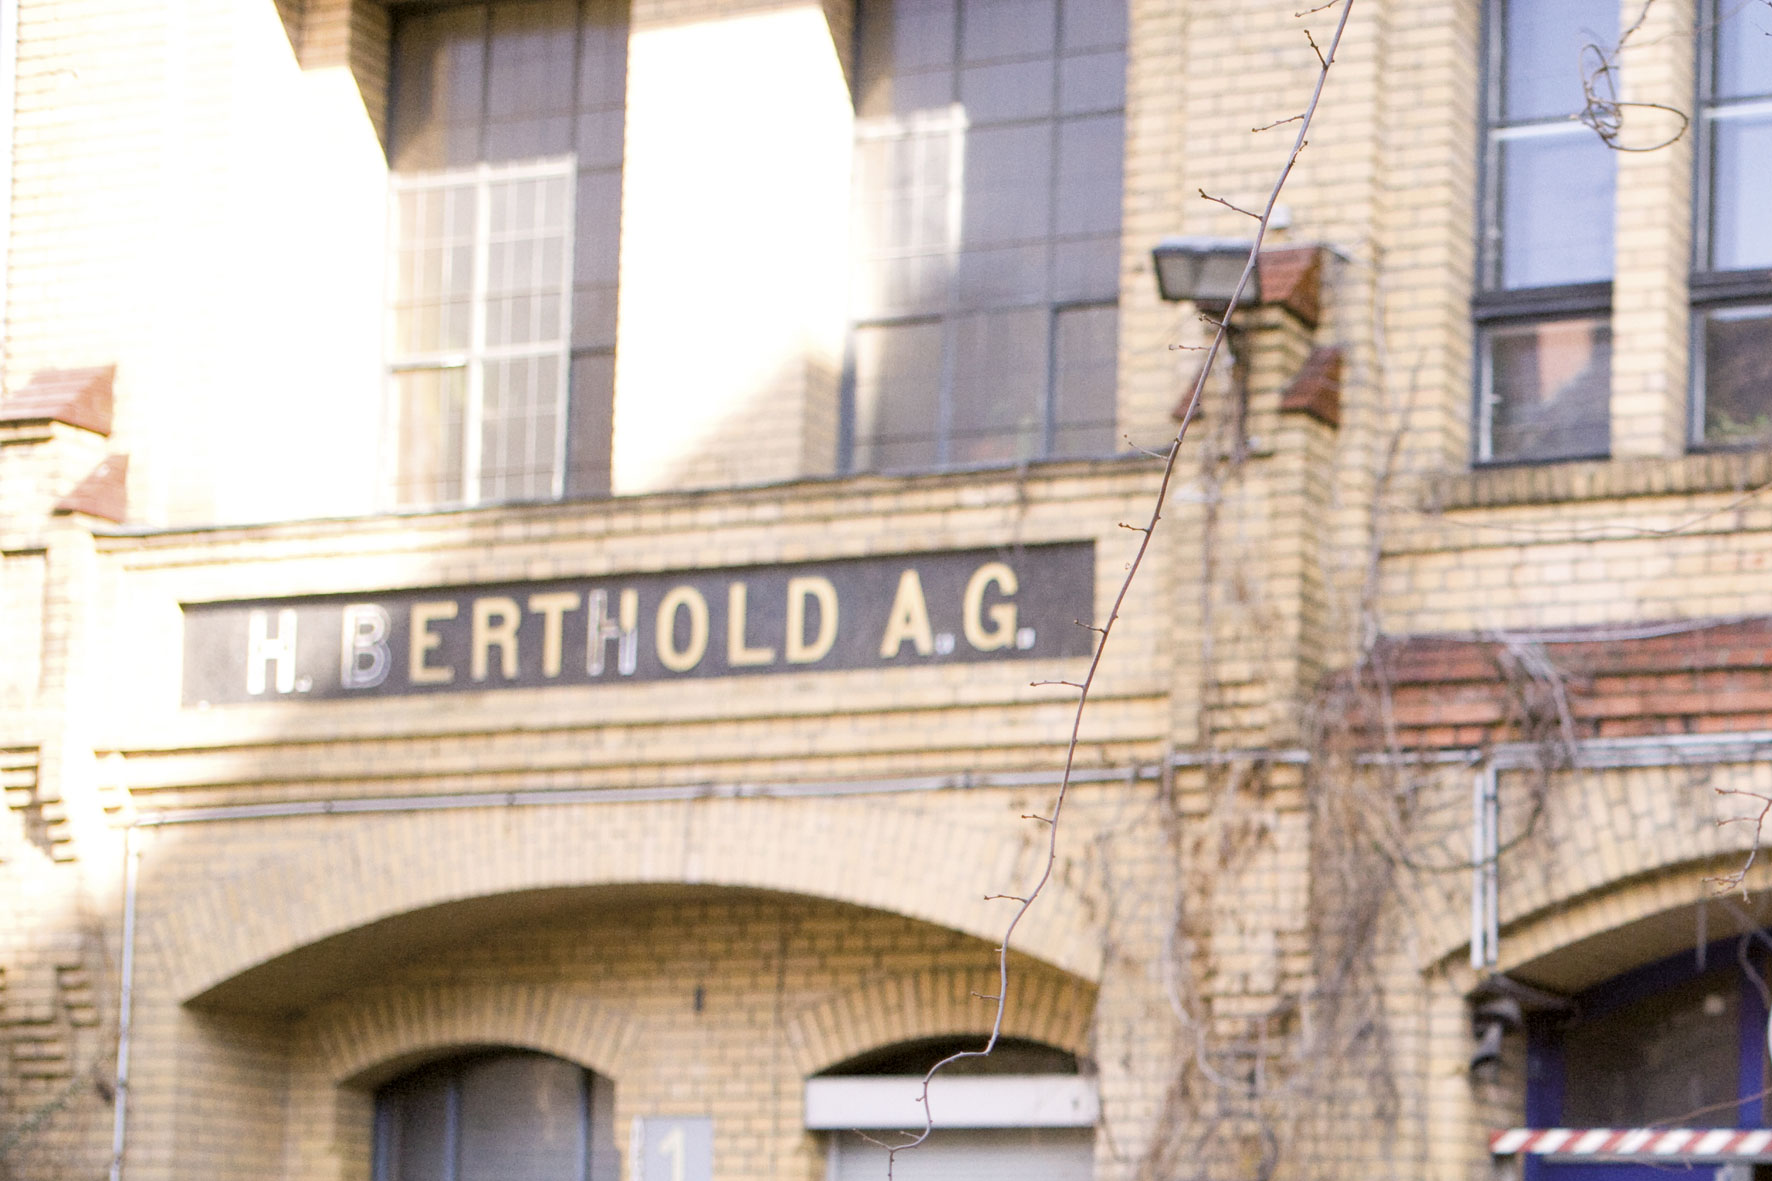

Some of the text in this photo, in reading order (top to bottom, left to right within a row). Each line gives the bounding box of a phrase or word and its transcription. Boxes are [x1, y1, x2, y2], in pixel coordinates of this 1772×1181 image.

[247, 561, 1036, 695] H. BERTHOLD A.G.
